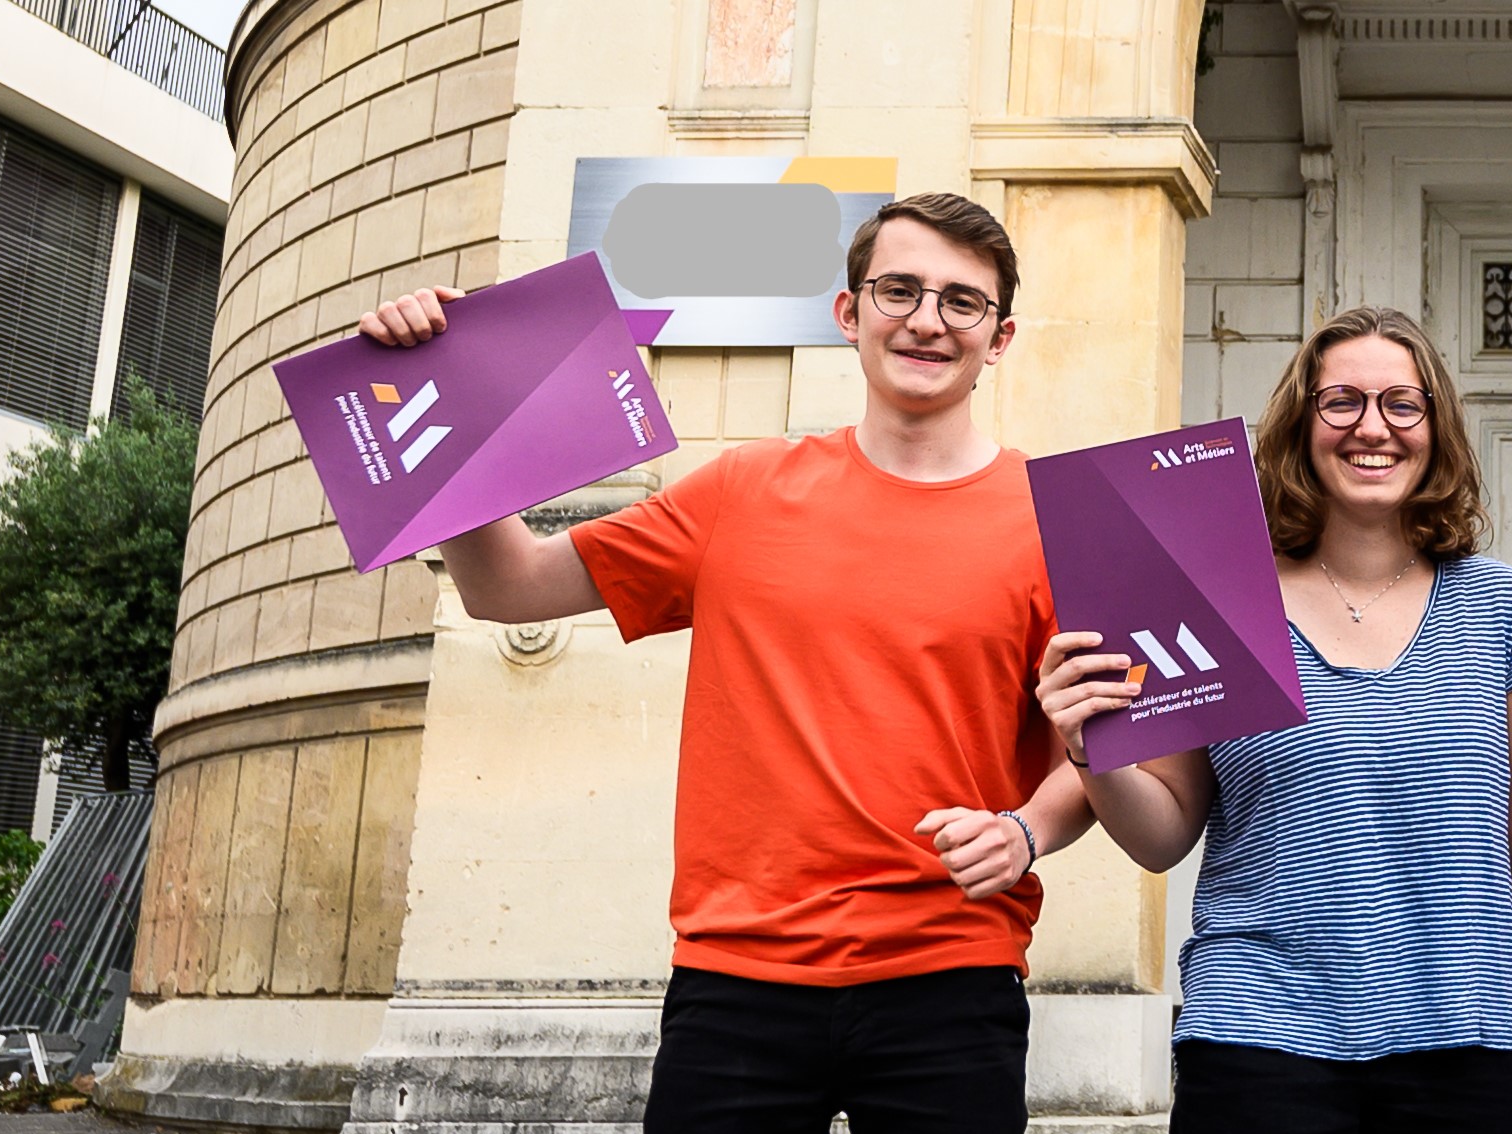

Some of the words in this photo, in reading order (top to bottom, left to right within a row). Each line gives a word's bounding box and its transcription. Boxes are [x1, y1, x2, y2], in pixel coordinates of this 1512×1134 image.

[334, 395, 351, 414] pour
[621, 400, 633, 412] et
[630, 397, 646, 418] Arts
[348, 391, 375, 440] Accélérateur
[626, 410, 647, 447] Métiers
[369, 441, 380, 452] de
[1183, 442, 1204, 454] Arts
[1185, 453, 1196, 464] et
[1197, 446, 1235, 461] Métiers
[361, 453, 372, 465] du
[374, 452, 392, 481] talents
[366, 465, 381, 485] futur
[1181, 688, 1192, 697] de
[1193, 682, 1223, 694] talents
[1131, 710, 1150, 722] pour
[1151, 700, 1191, 716] l'industrie
[1193, 696, 1203, 706] du
[1204, 692, 1225, 702] futur
